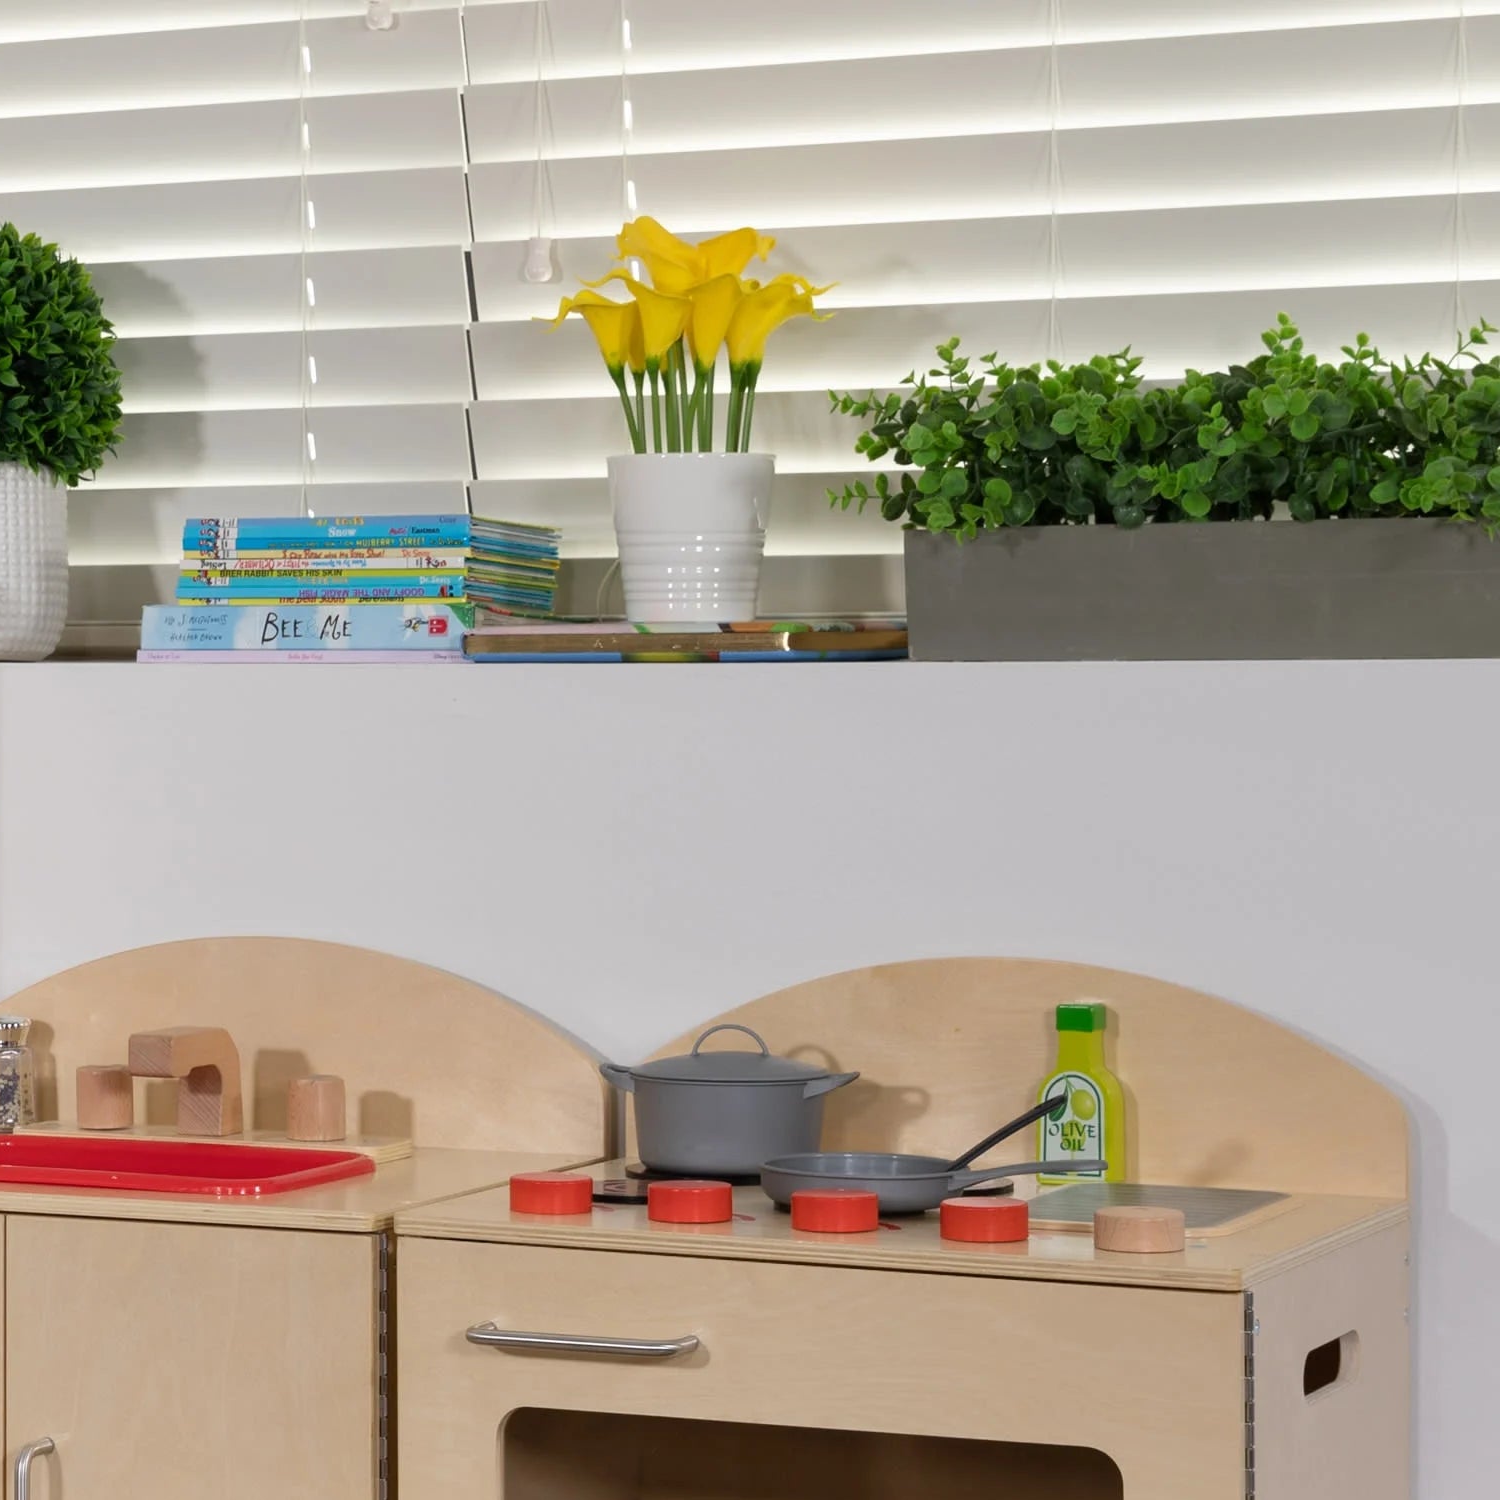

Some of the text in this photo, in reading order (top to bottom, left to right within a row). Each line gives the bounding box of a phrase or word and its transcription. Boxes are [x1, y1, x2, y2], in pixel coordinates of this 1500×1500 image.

[328, 526, 357, 537] Snow
[399, 537, 425, 546] STREET
[306, 569, 320, 577] HIS
[298, 588, 425, 598] GOOFY AND THE MAGIC FISH
[261, 611, 303, 645] BEE
[320, 614, 353, 640] ME
[1048, 1123, 1097, 1138] OLIVE
[1060, 1138, 1086, 1151] OIL
